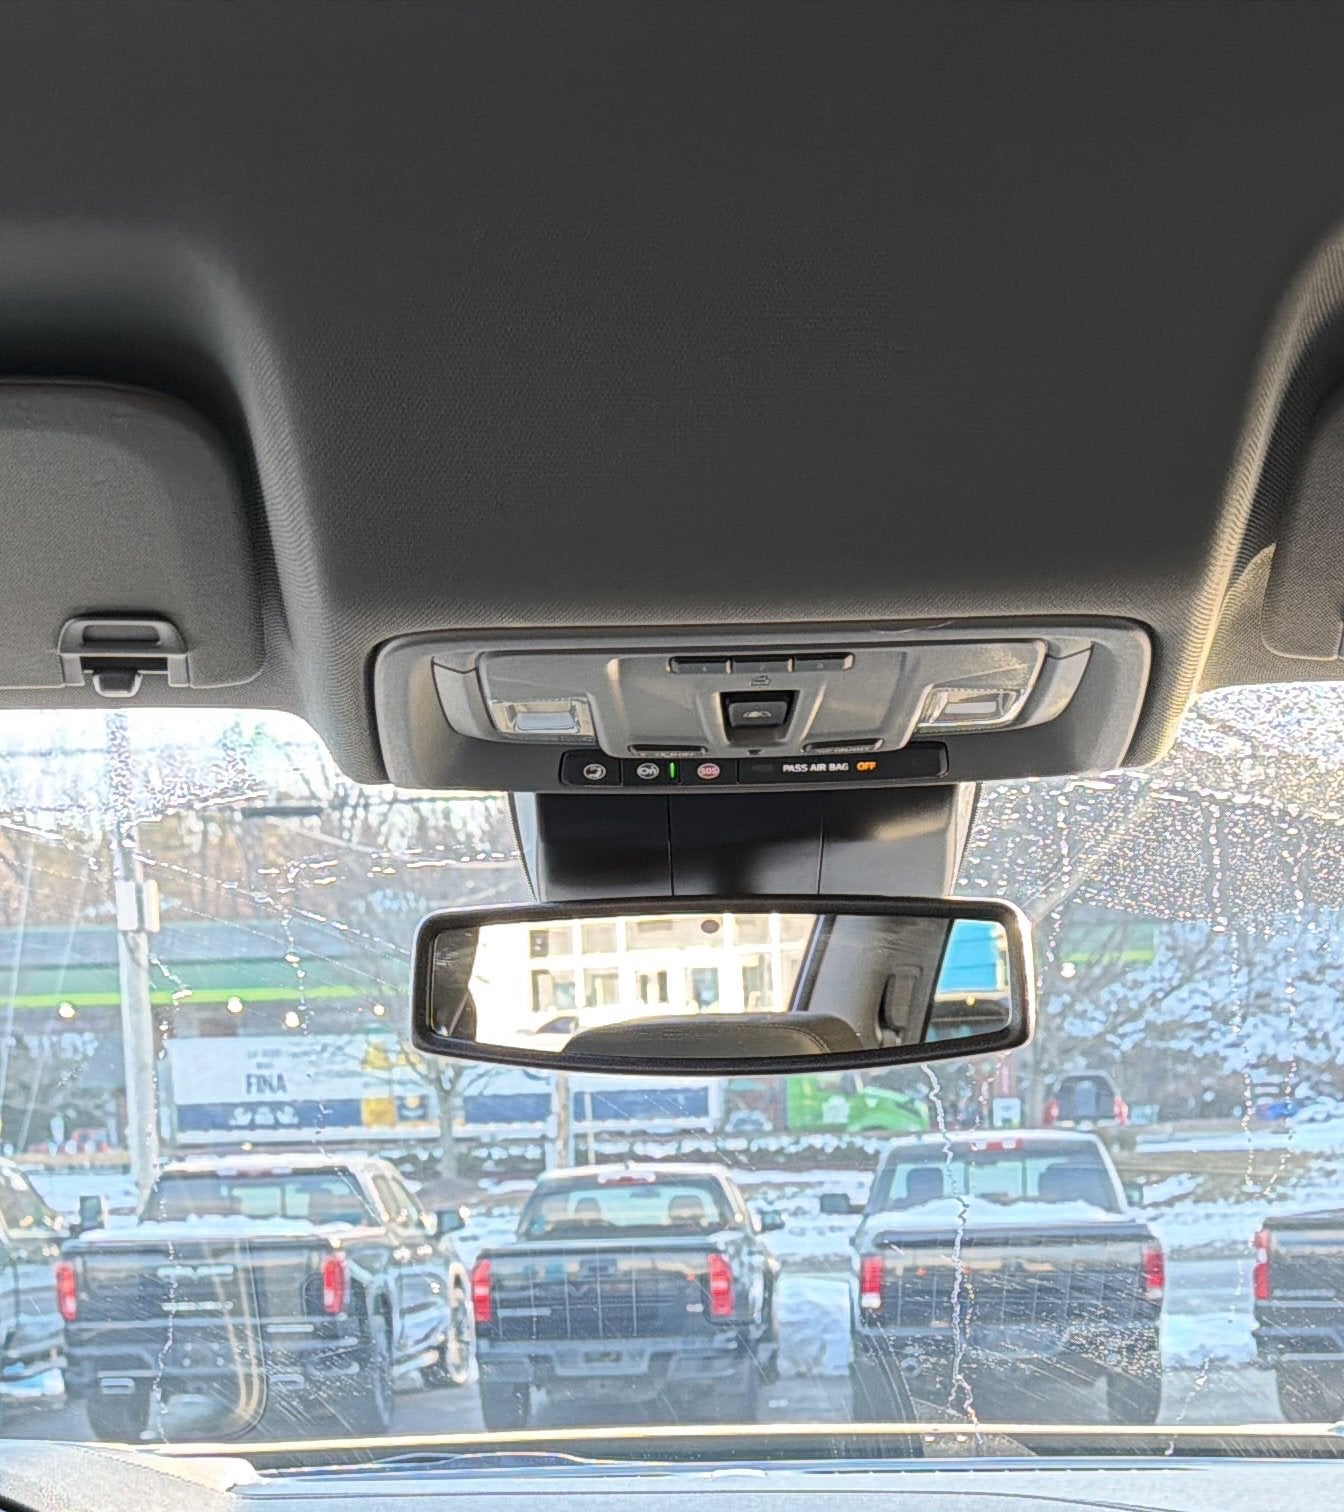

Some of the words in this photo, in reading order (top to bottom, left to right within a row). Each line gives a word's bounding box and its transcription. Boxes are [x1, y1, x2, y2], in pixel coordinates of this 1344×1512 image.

[700, 767, 718, 775] SOS
[783, 763, 808, 772] PASS
[810, 763, 826, 772] AIR
[829, 762, 849, 771] BAG
[856, 762, 876, 770] OFF
